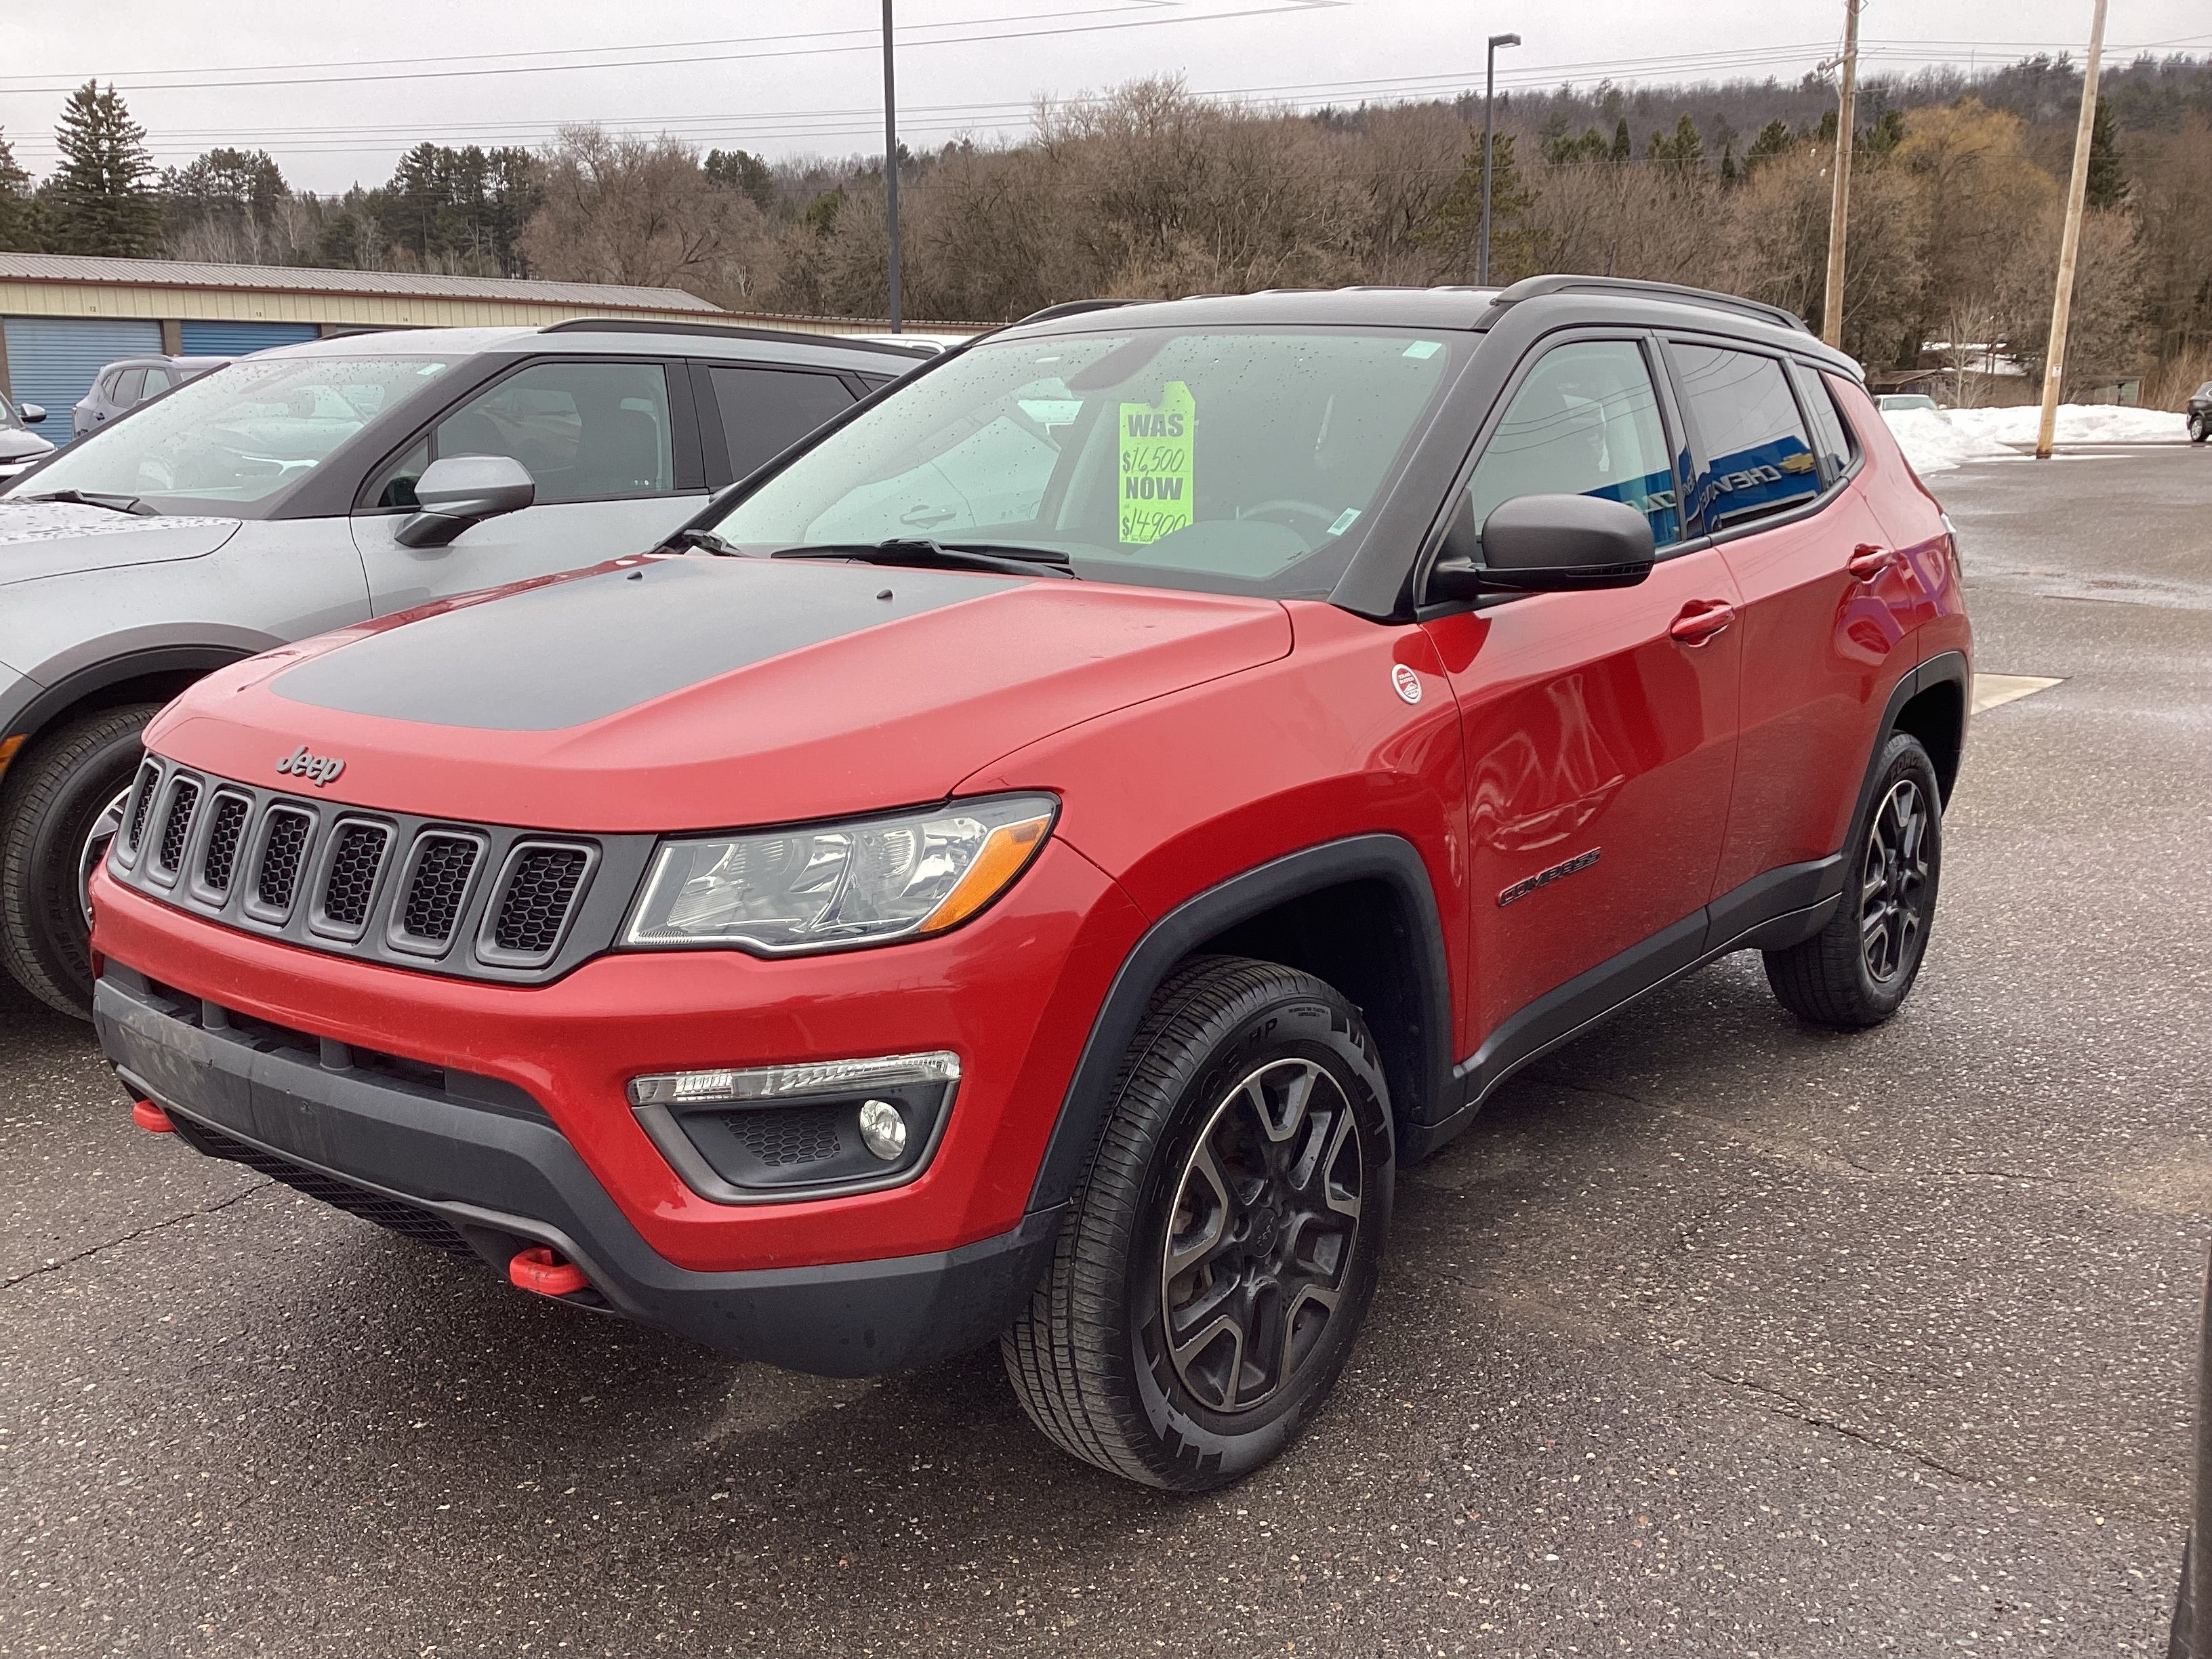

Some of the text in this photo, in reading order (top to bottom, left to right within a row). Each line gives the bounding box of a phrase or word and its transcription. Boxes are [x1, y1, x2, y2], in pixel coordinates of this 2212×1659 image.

[1128, 413, 1184, 437] WAS
[1122, 446, 1185, 477] $16,500
[1126, 476, 1184, 500] NOW
[276, 745, 346, 787] Jeep
[1498, 846, 1601, 907] COMPASS
[1248, 1017, 1278, 1046] HP
